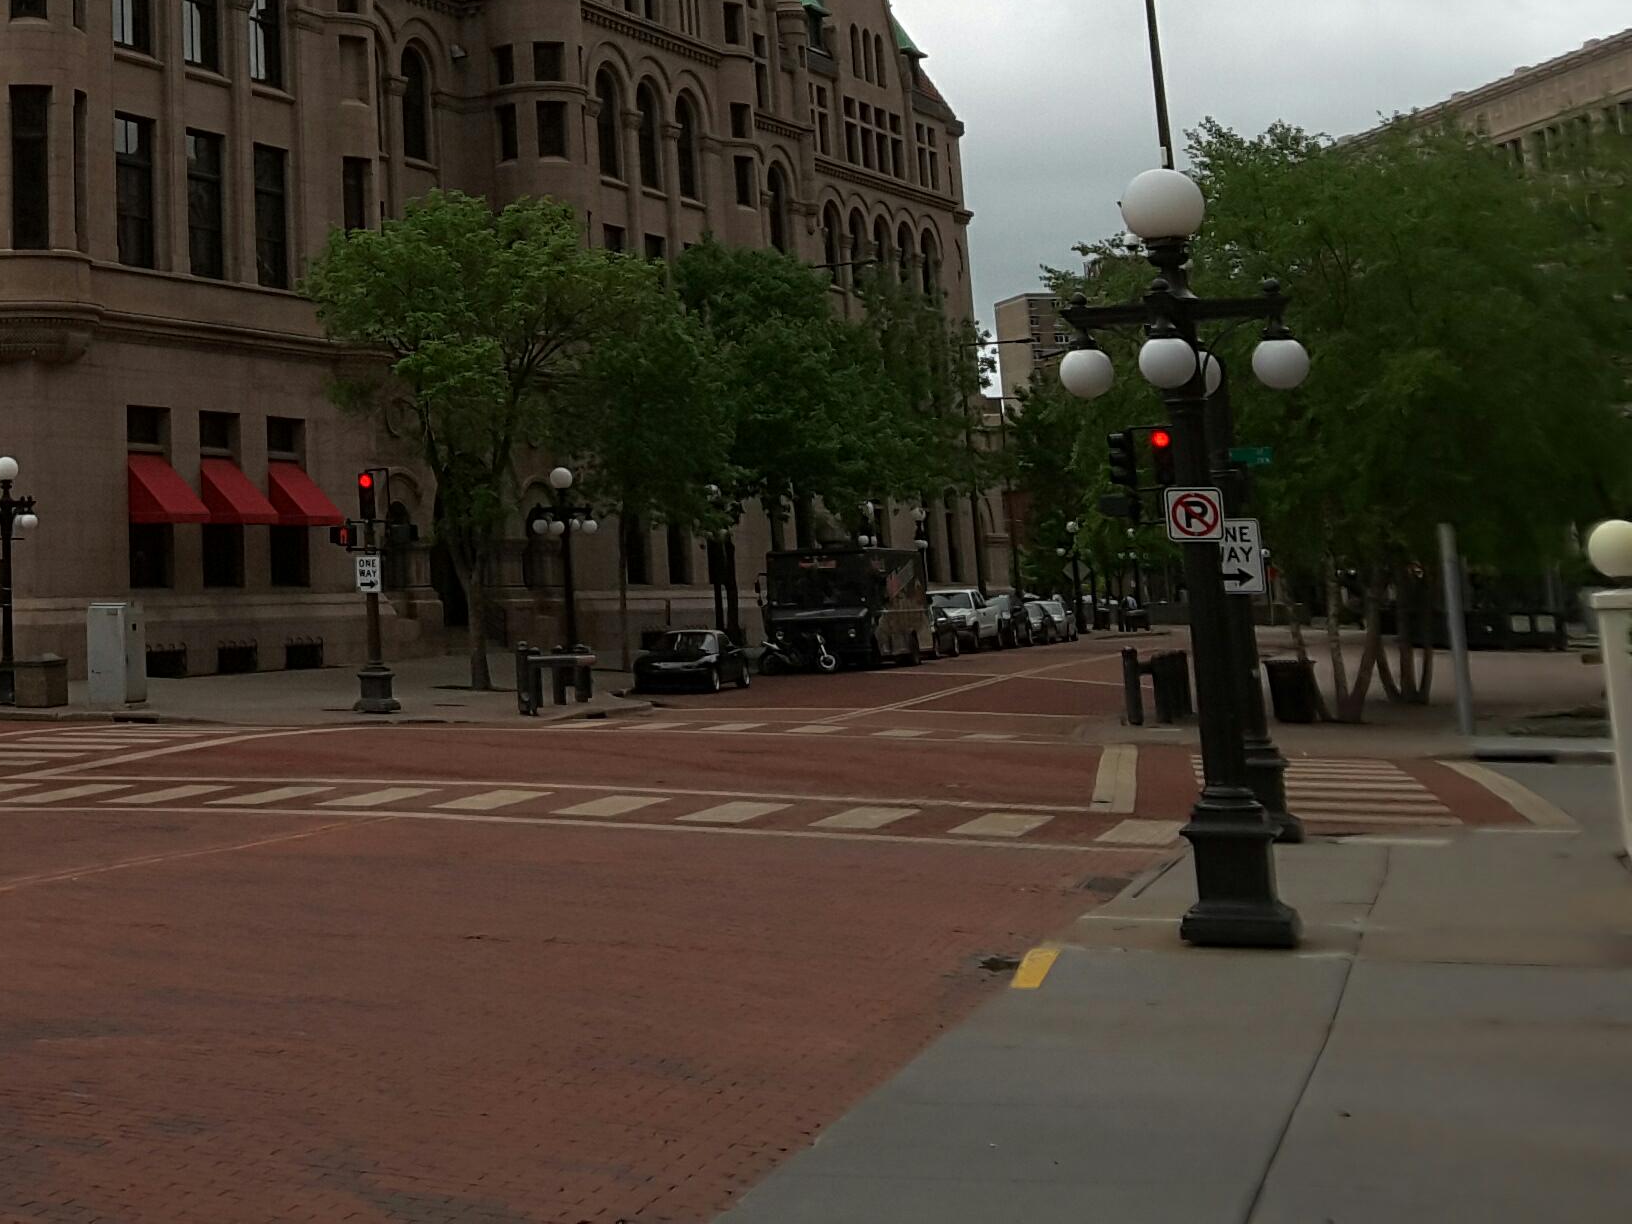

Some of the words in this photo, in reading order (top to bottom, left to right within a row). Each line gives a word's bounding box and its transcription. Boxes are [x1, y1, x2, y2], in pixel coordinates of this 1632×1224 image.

[1224, 526, 1252, 543] NE
[1220, 545, 1253, 564] AY
[359, 559, 376, 567] ONE
[359, 569, 377, 577] WAY
